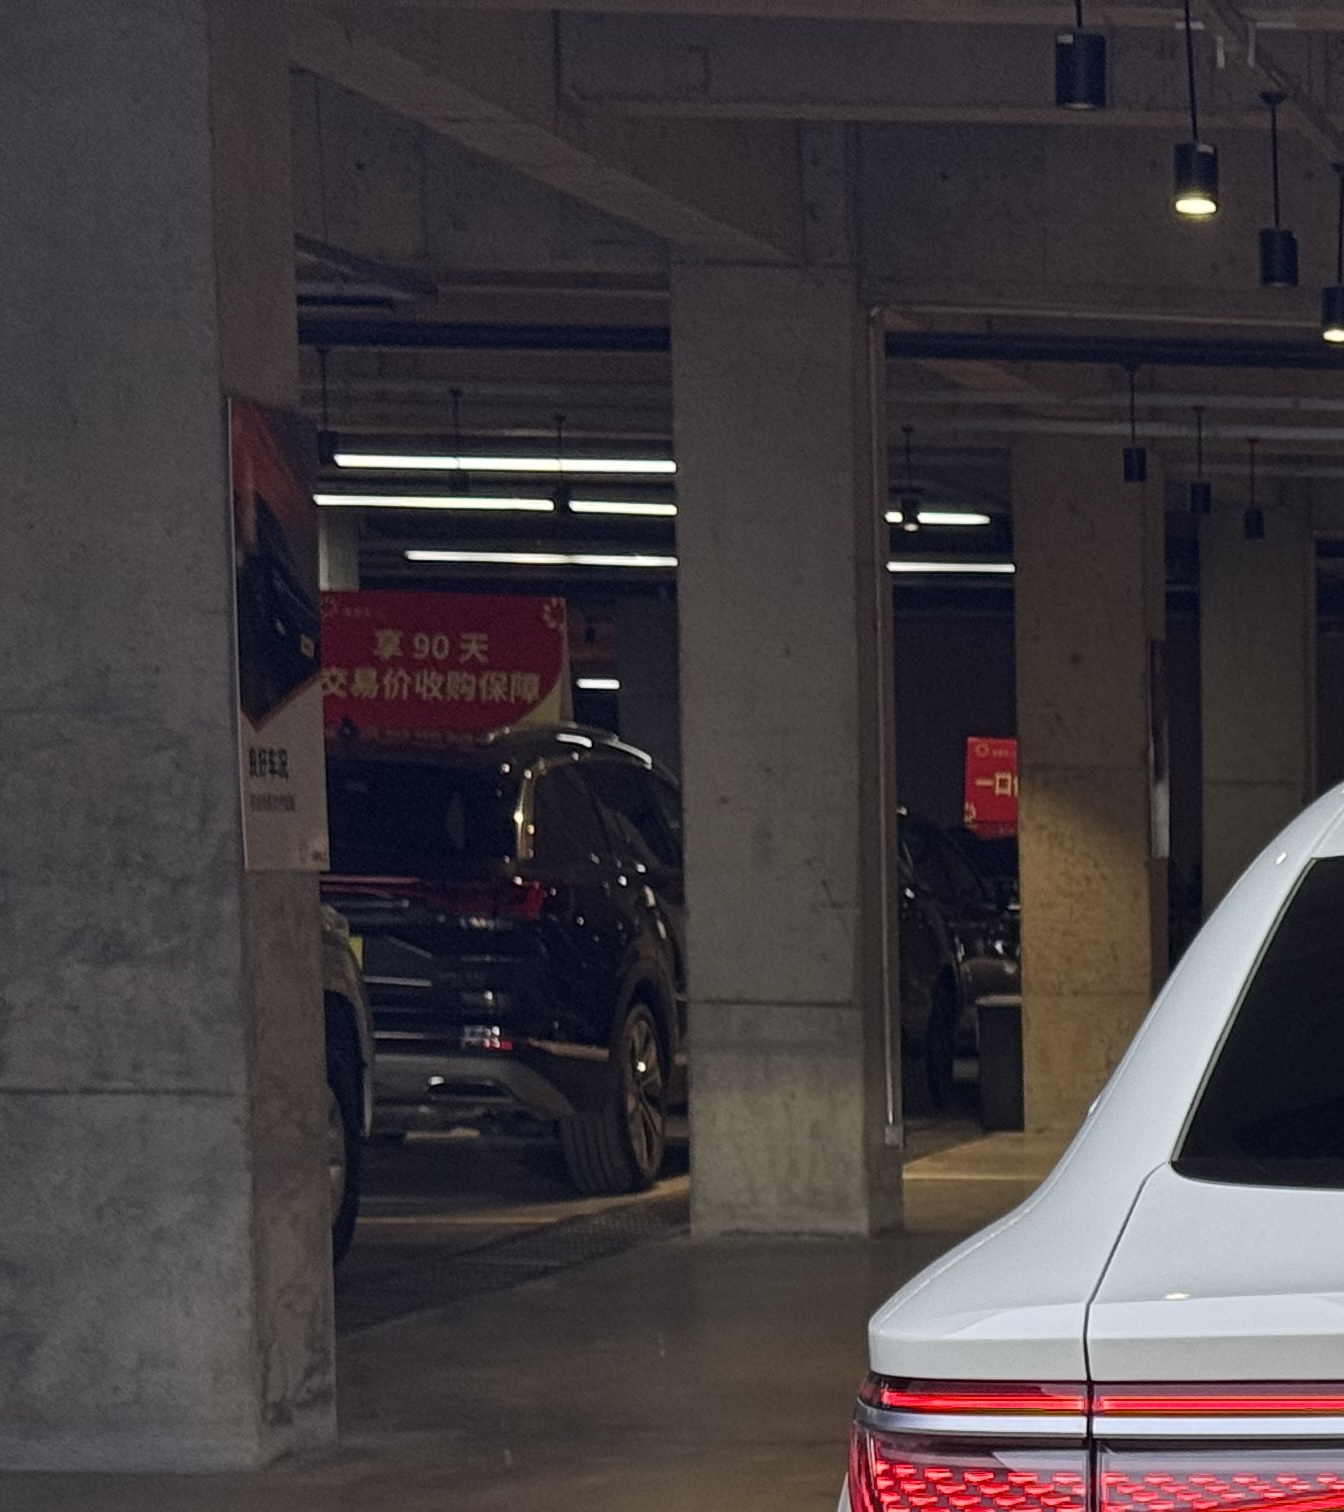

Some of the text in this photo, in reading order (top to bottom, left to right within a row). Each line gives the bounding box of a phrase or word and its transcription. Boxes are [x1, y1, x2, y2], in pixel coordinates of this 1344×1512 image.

[320, 666, 541, 705] 交易价收购保障
